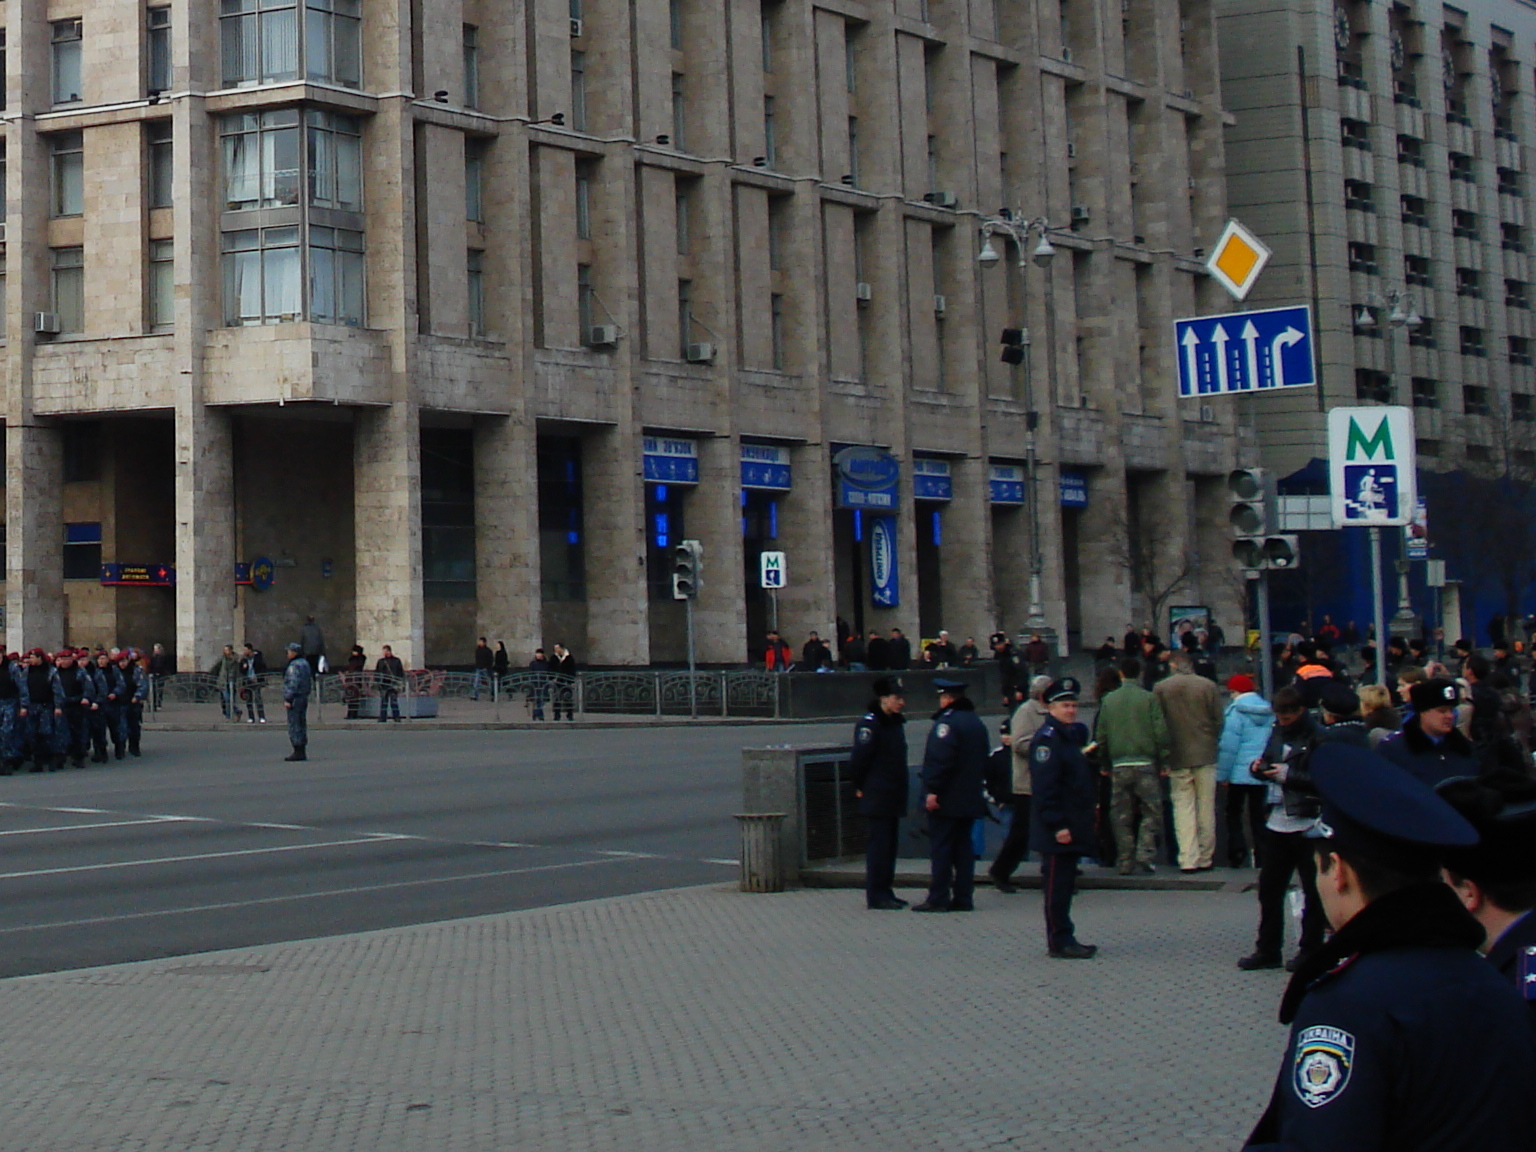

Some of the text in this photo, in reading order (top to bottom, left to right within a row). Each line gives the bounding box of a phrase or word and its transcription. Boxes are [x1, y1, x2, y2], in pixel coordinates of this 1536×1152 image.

[1346, 414, 1395, 460] М
[766, 555, 779, 568] М
[1303, 1028, 1347, 1046] УКРАЇНА
